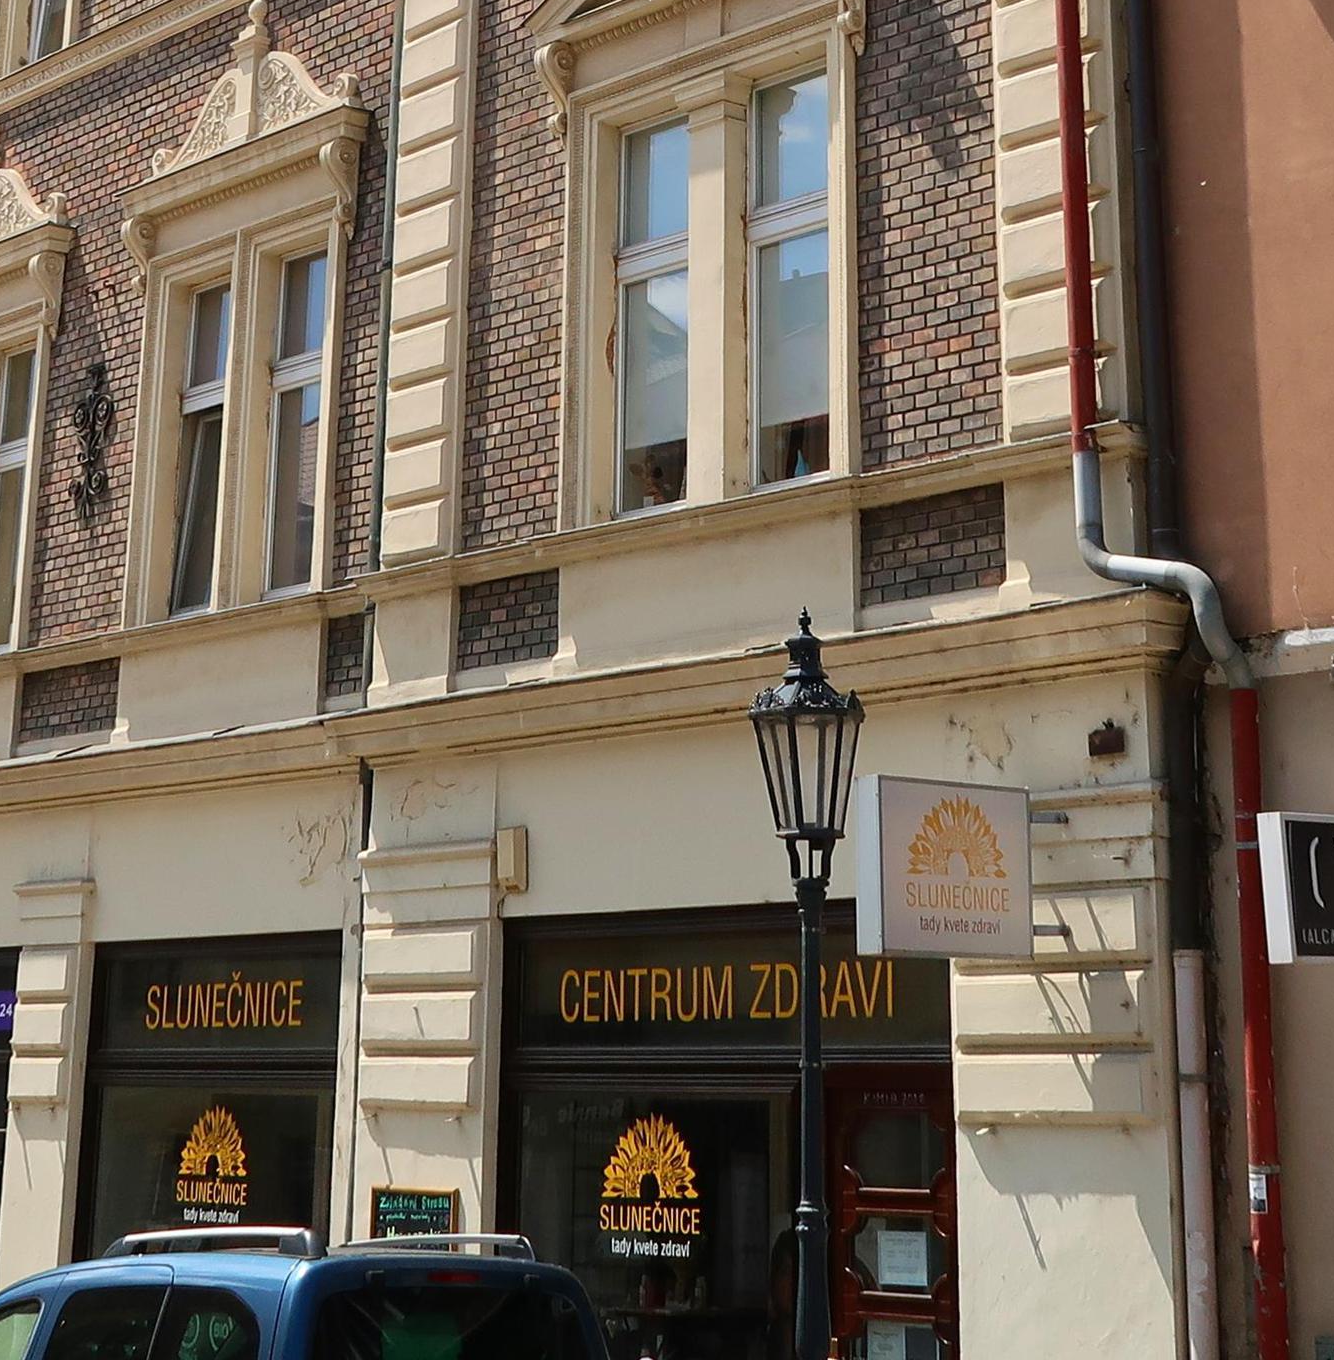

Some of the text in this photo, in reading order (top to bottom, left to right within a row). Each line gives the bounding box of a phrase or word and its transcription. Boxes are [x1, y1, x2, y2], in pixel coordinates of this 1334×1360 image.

[906, 881, 1010, 912] SLUNEČNICE
[919, 915, 1001, 935] tady kvete zdraví
[145, 970, 304, 1030] SLUNEČNICE
[559, 964, 734, 1024] CENTRUM
[176, 1177, 247, 1206] SLUNEČNICE
[183, 1206, 199, 1224] tady
[199, 1207, 217, 1222] kvete
[599, 1201, 701, 1235] SLUNEČNICE
[611, 1237, 690, 1258] tady kvete zdraví
